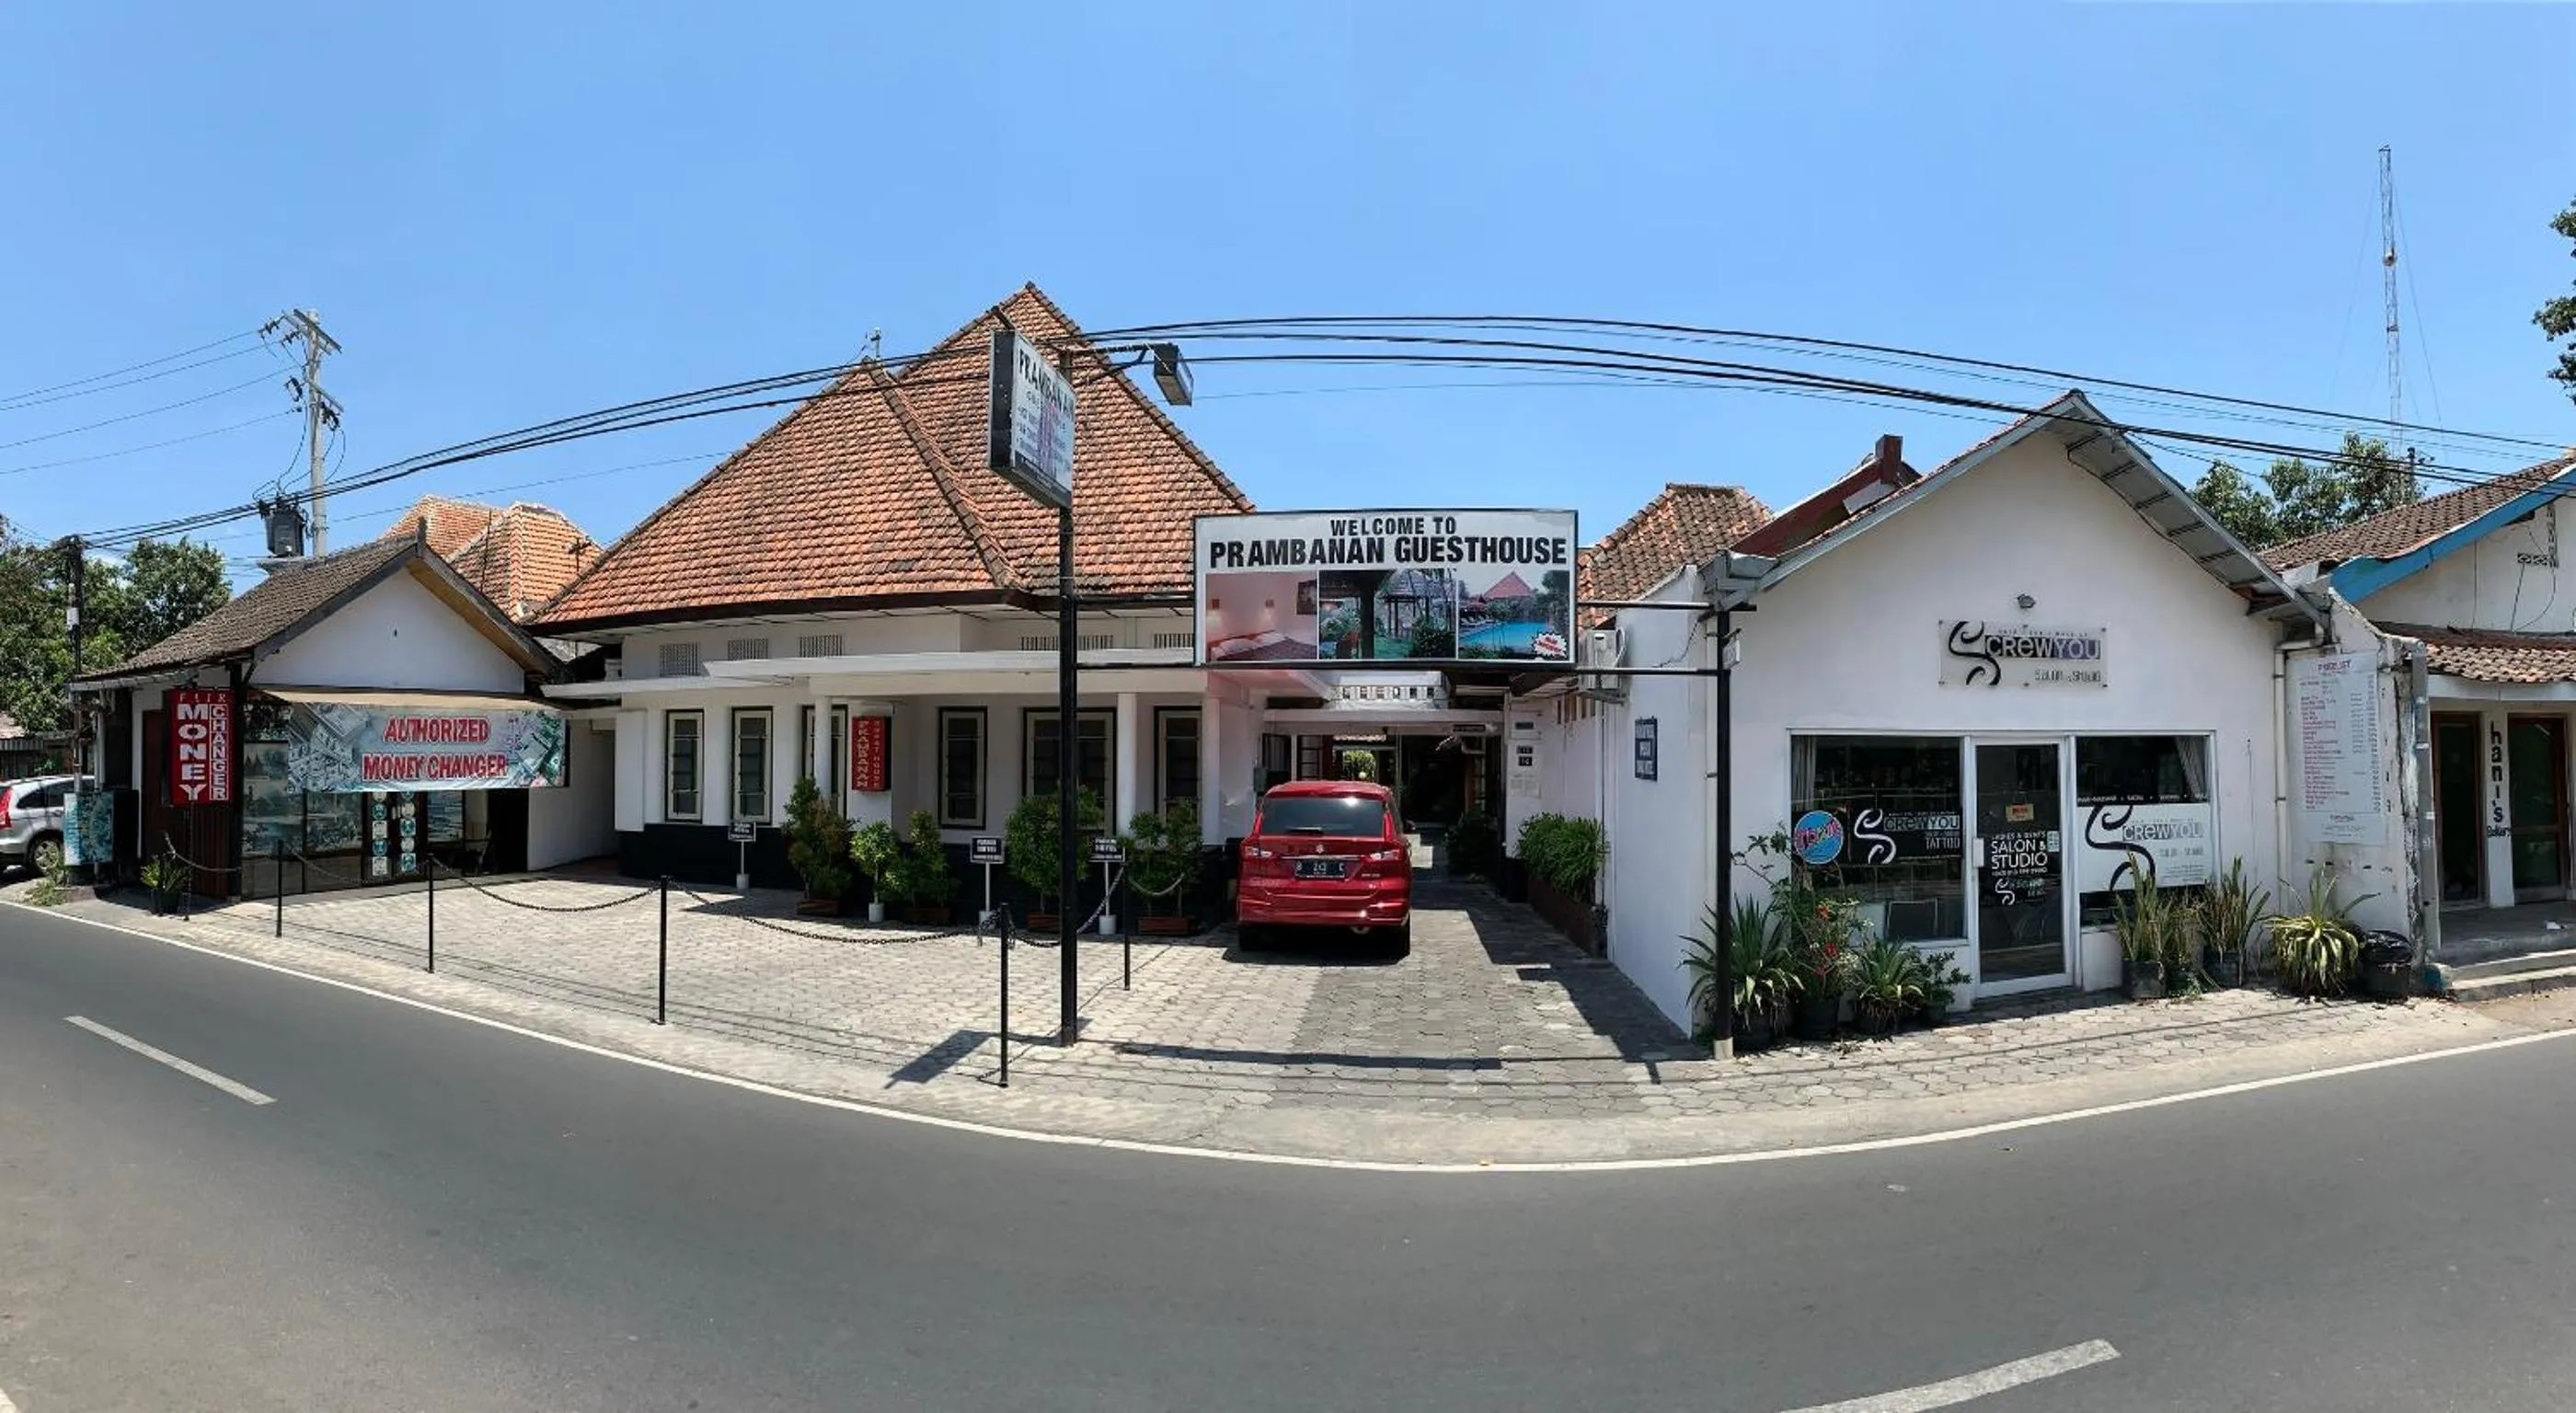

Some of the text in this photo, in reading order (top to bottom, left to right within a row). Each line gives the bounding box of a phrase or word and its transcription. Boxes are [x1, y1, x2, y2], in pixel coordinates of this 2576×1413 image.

[1330, 516, 1456, 536] WELCOME TO
[1210, 535, 1567, 568] PRAMBANAN GUESTHOUSE
[382, 717, 491, 744] AUTHORIZED
[178, 704, 208, 801] MONEY
[213, 705, 226, 800] CHANGER
[362, 752, 509, 781] MONEY CHANGER
[1991, 839, 2036, 854] SALON
[1991, 852, 2048, 869] STUDIO
